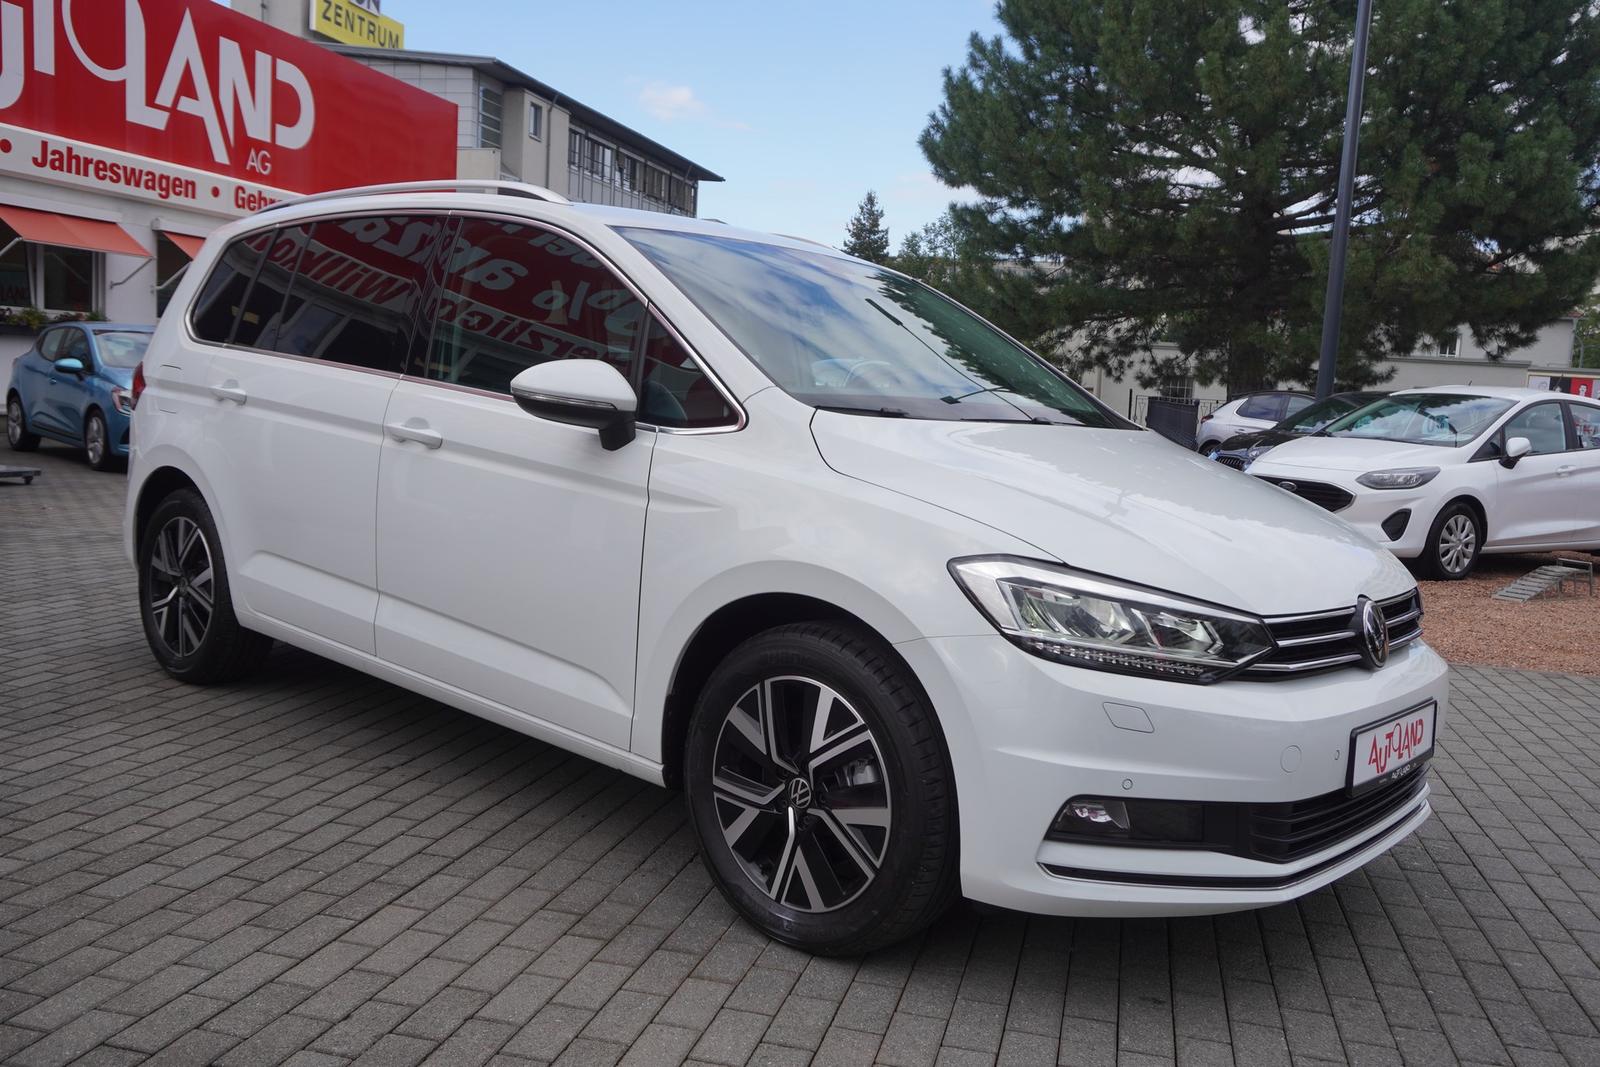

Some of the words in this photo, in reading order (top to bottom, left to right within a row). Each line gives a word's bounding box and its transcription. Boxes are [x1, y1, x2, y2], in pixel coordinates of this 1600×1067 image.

[322, 0, 400, 49] ZENTRUM
[32, 140, 198, 200] Jahreswagen
[246, 148, 273, 176] AG
[1368, 718, 1424, 774] AUTOLAND
